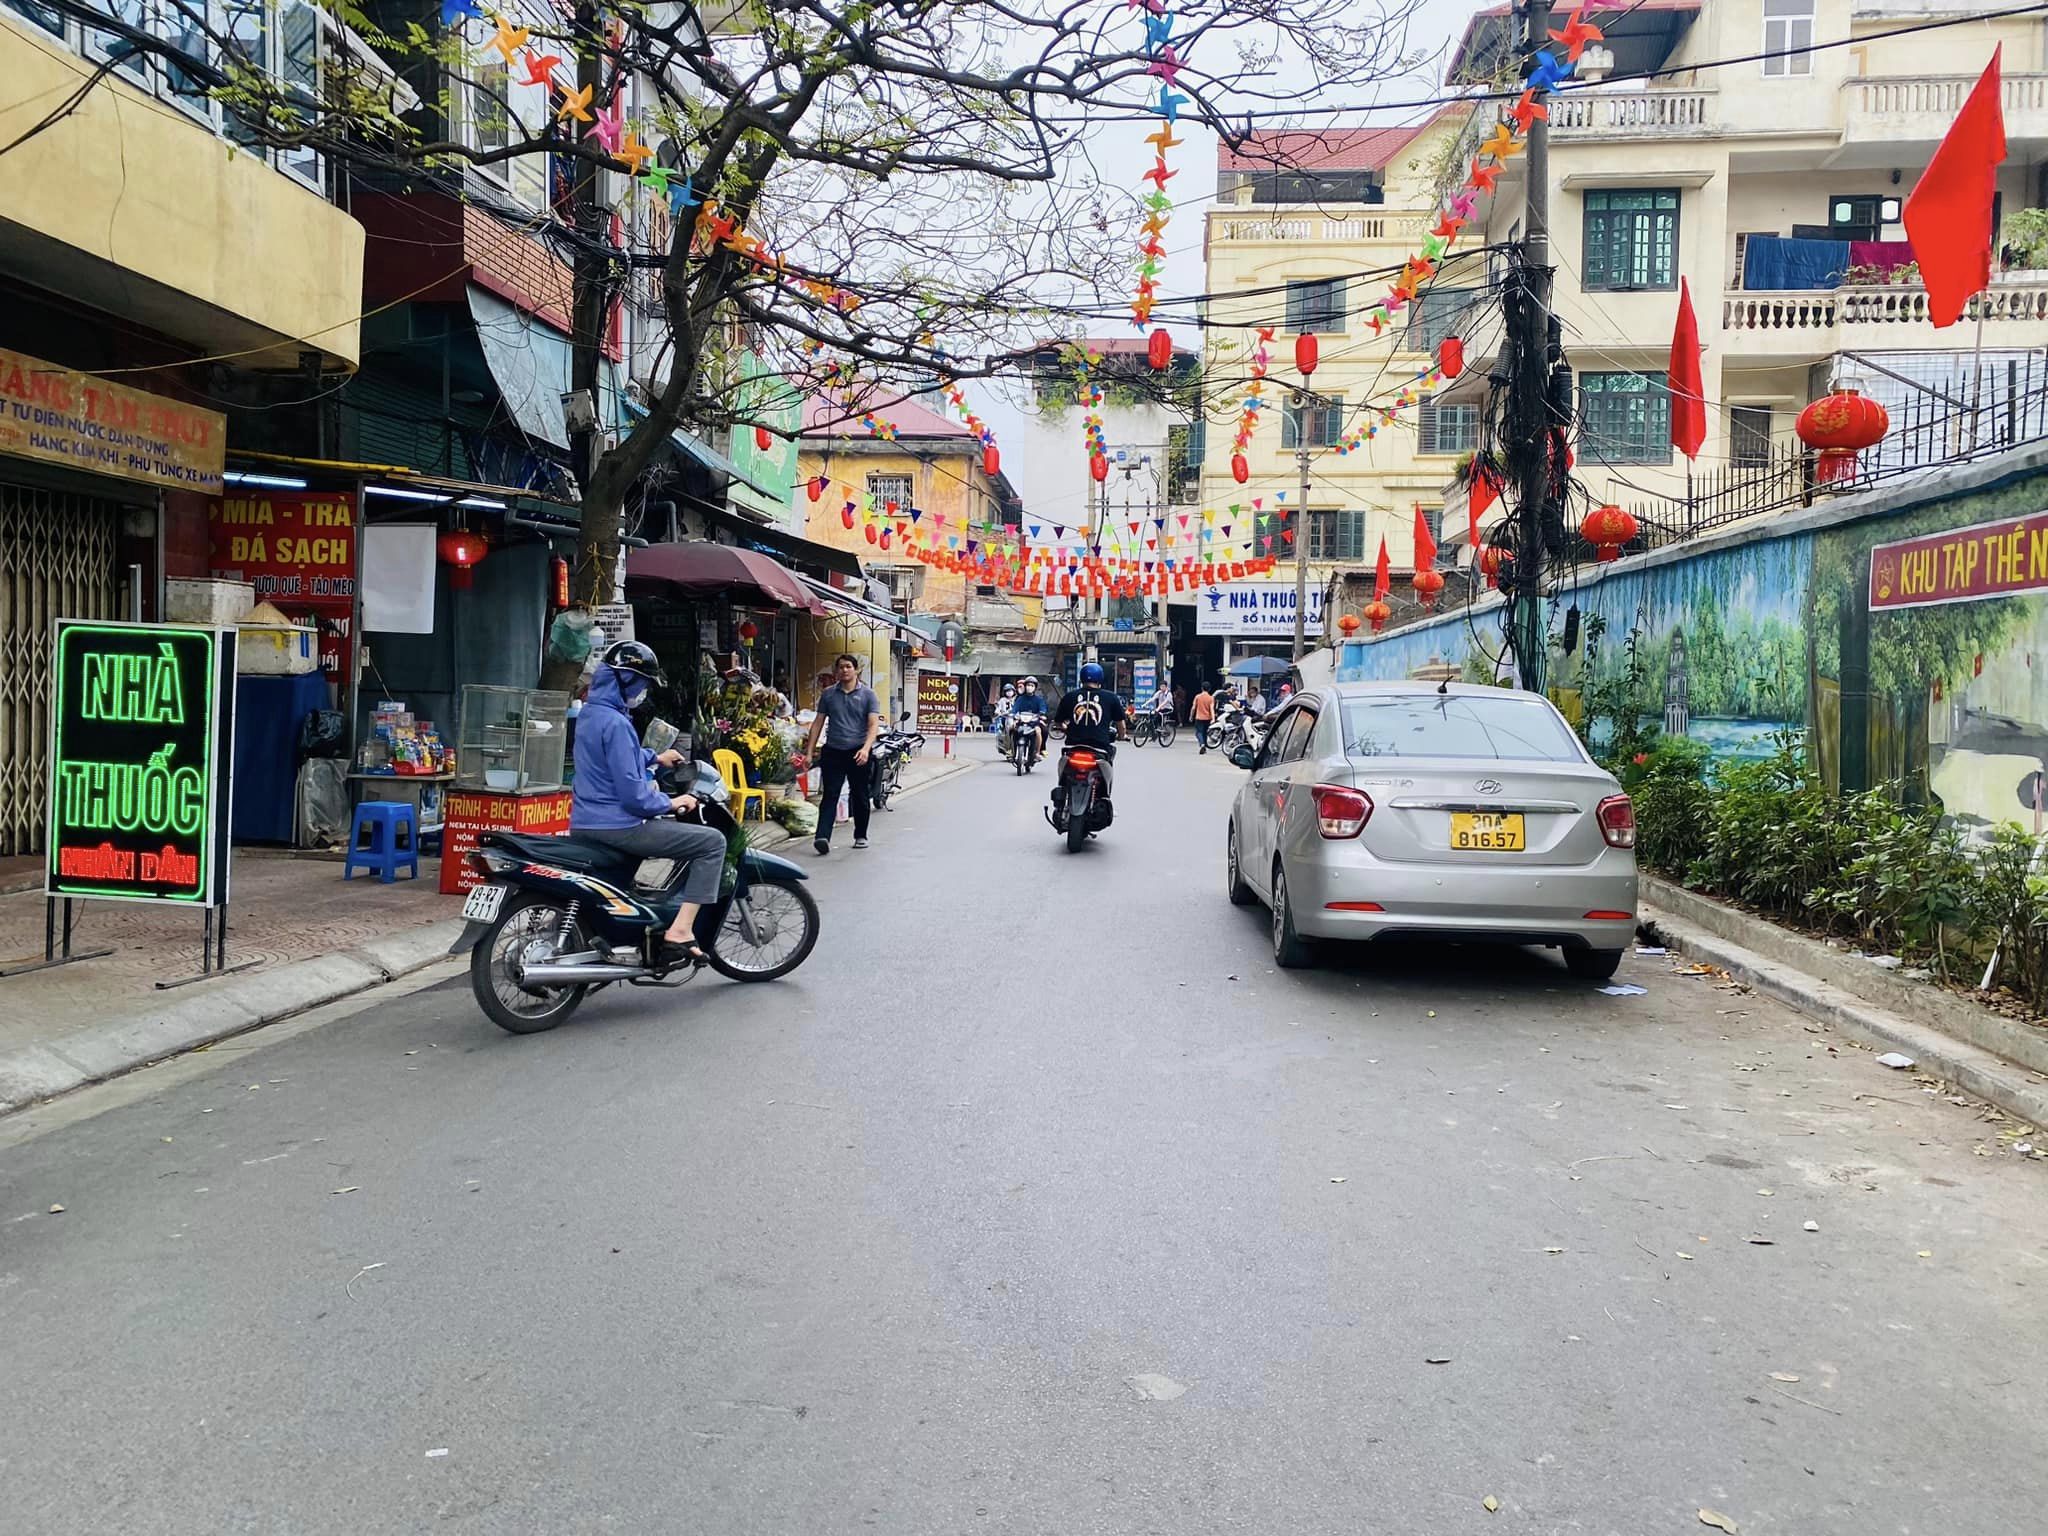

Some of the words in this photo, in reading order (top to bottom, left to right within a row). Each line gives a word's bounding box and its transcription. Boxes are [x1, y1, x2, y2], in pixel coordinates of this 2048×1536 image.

[186, 467, 197, 482] XE
[223, 494, 274, 524] MÍA
[302, 495, 351, 527] TRÀ
[231, 532, 267, 562] ĐÁ
[276, 537, 348, 569] SẠCH
[1901, 547, 1938, 596] KHU
[1230, 588, 1257, 608] NHÀ
[1262, 588, 1305, 608] THUỐ
[1242, 611, 1258, 623] SỐ
[1262, 615, 1267, 623] 1
[1270, 615, 1297, 623] NAM
[82, 642, 184, 723] NHÀ
[927, 679, 949, 687] NEM
[61, 743, 203, 835] THUỐC
[448, 794, 481, 817] TRÌNH
[490, 798, 516, 820] BÍCH
[492, 824, 513, 832] SUNG
[1459, 832, 1516, 848] 816.57
[60, 842, 135, 881] NHÂN
[141, 845, 198, 885] DÂN
